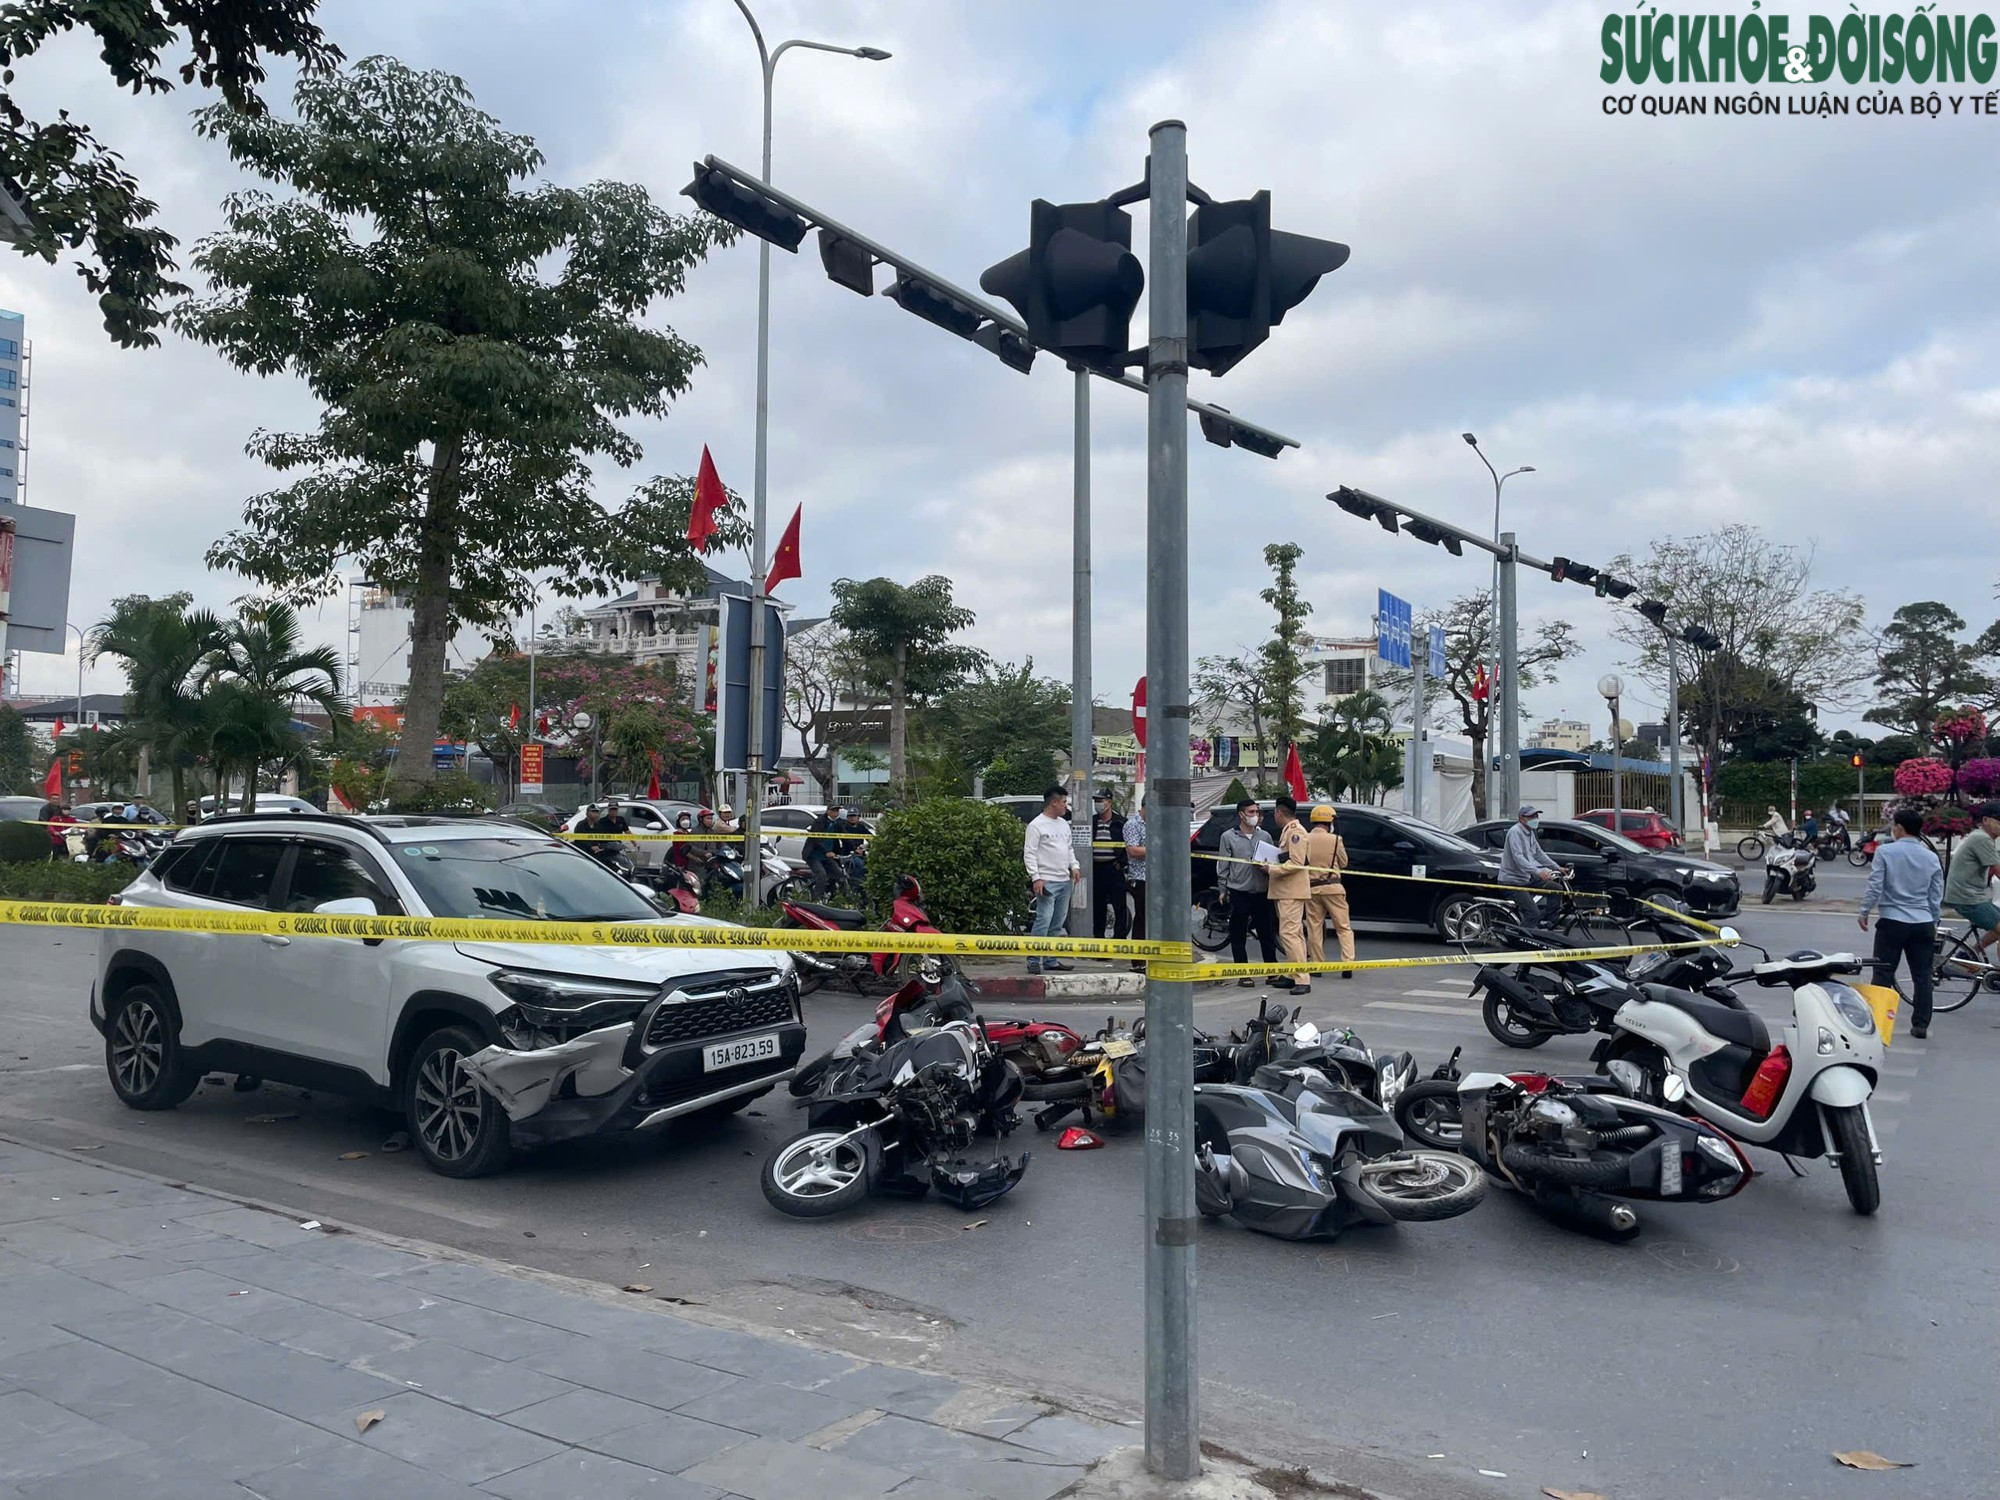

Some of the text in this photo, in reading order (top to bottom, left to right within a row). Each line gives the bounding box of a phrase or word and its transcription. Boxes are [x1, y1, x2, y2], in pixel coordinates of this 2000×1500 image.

[1685, 959, 1704, 971] 160
[1149, 1128, 1180, 1141] 25 35
